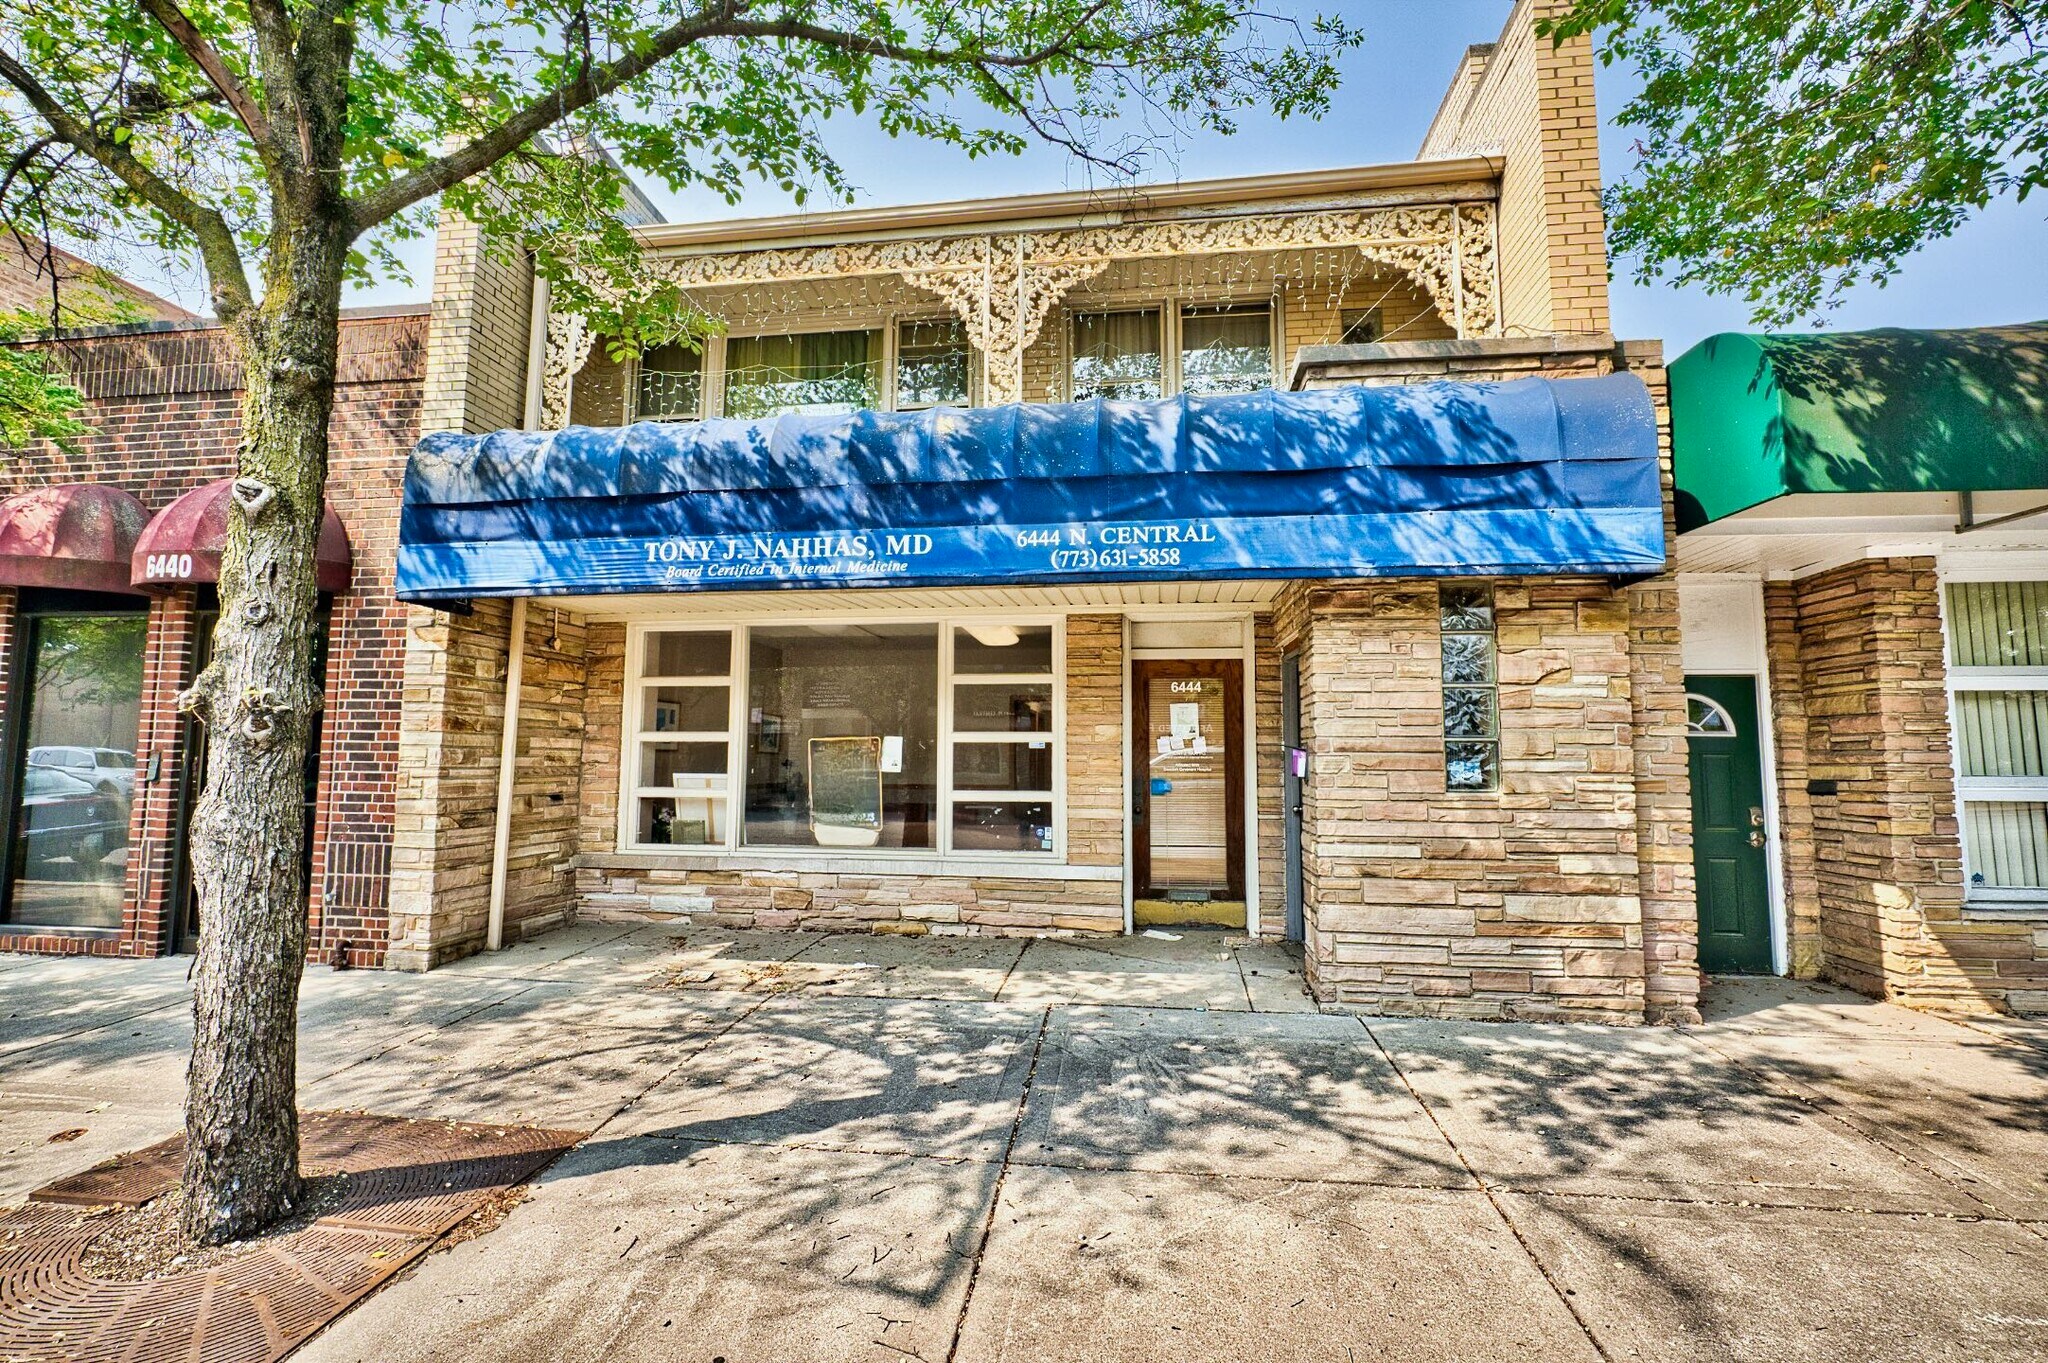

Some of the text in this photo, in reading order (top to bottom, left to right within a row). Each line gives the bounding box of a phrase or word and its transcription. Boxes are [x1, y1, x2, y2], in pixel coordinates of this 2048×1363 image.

[1017, 525, 1215, 547] 6444 N. CENTRAL
[644, 534, 933, 562] TONY J. NAHHAS, MD
[1050, 547, 1181, 569] (773)631-5858
[146, 554, 192, 578] 6440
[666, 559, 908, 578] Board Certified in Internal Medicine
[1170, 681, 1202, 693] 6444
